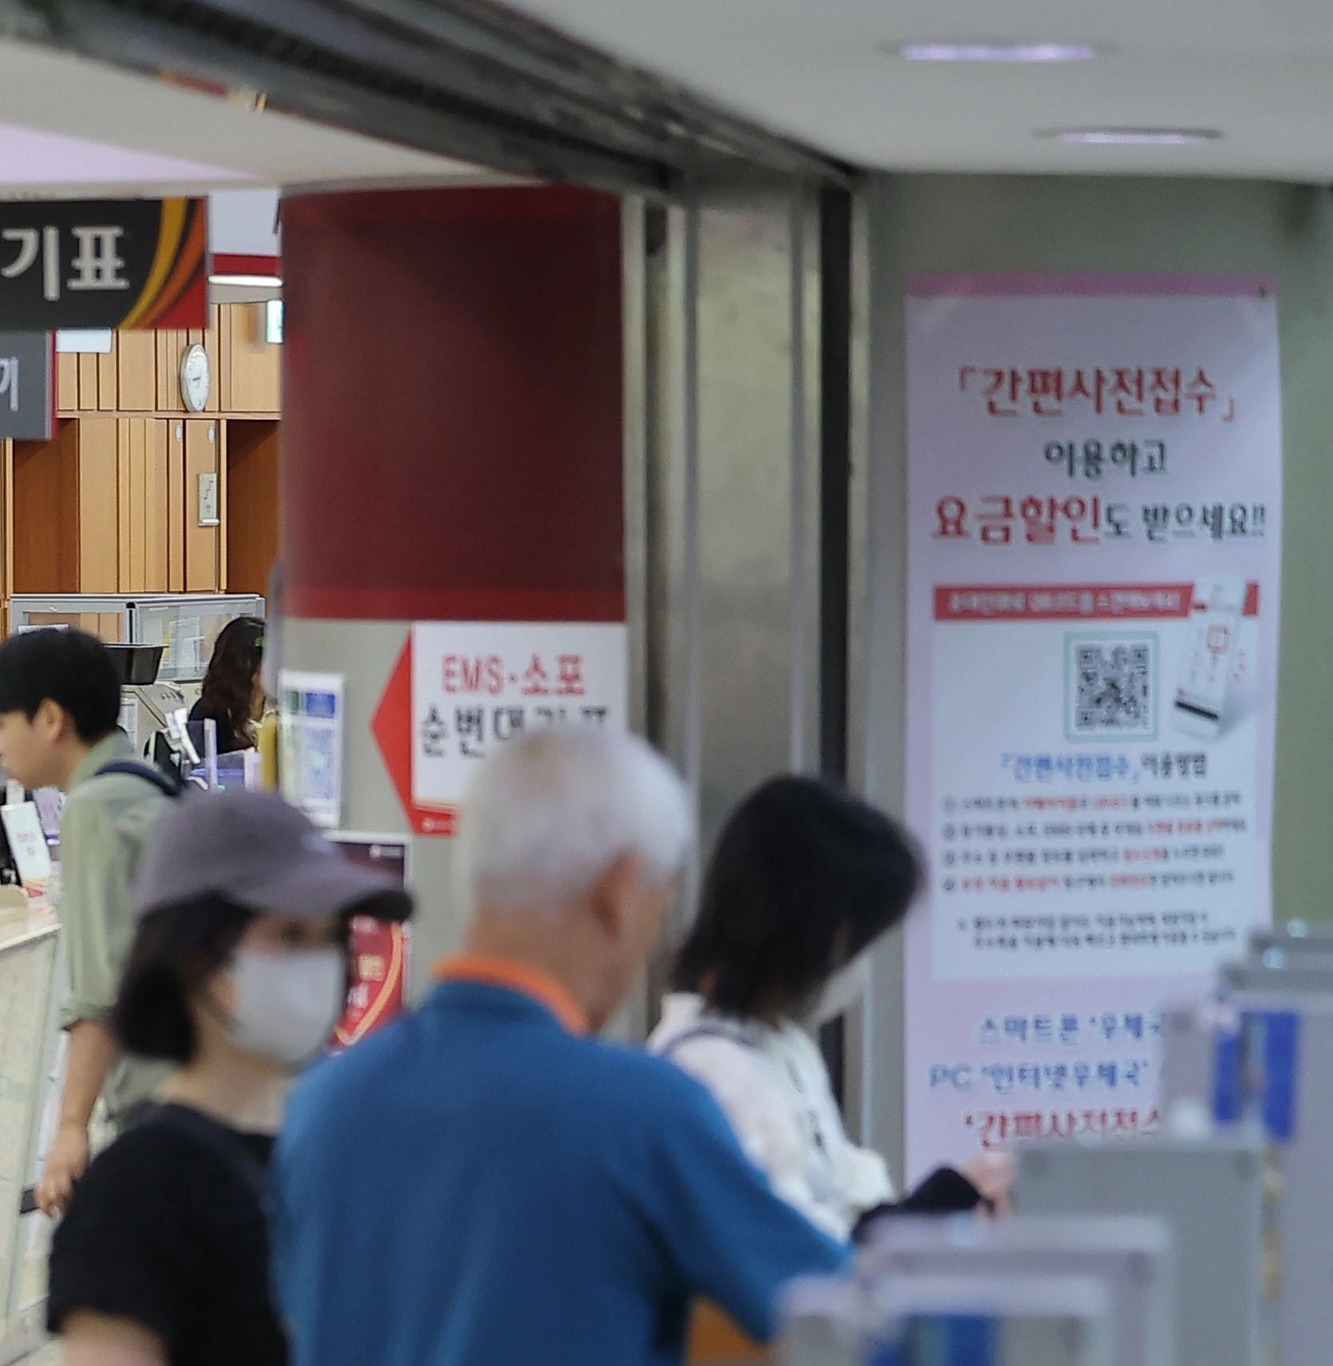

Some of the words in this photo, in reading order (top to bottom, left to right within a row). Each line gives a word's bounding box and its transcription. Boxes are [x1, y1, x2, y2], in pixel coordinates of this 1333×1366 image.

[1043, 440, 1168, 480] 이용하고
[933, 495, 1131, 545] 요금할인도
[930, 1063, 972, 1089] PC
